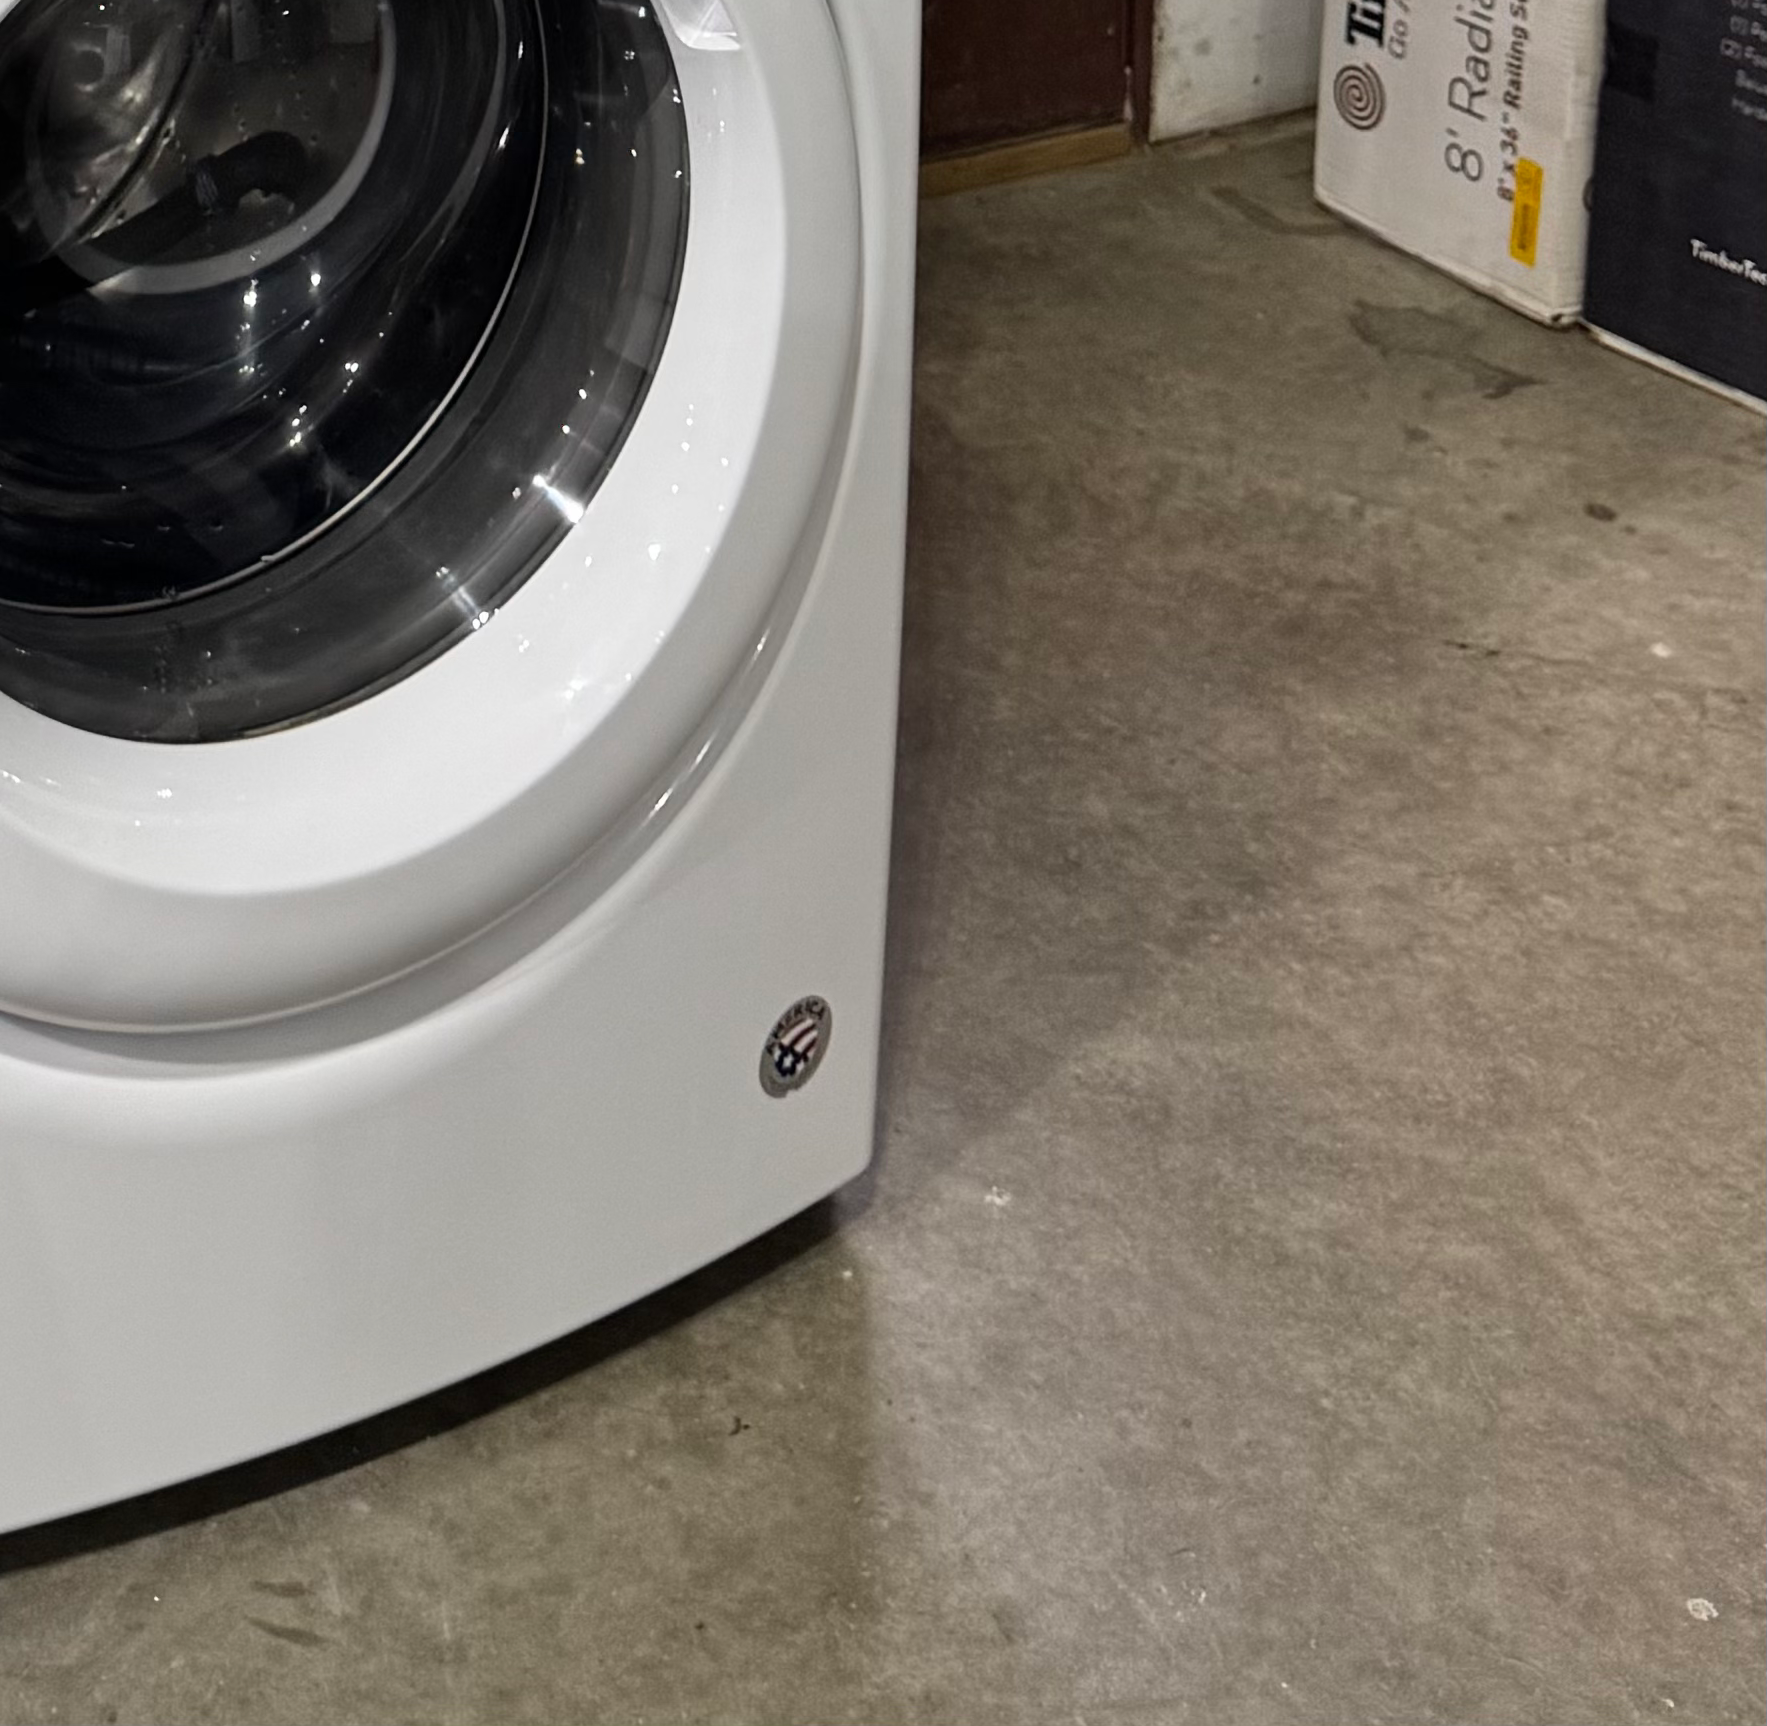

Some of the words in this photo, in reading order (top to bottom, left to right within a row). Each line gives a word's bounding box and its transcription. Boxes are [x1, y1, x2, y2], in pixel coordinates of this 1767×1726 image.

[1387, 20, 1408, 60] Go
[1503, 24, 1530, 110] Railing
[1445, 126, 1483, 183] 8'
